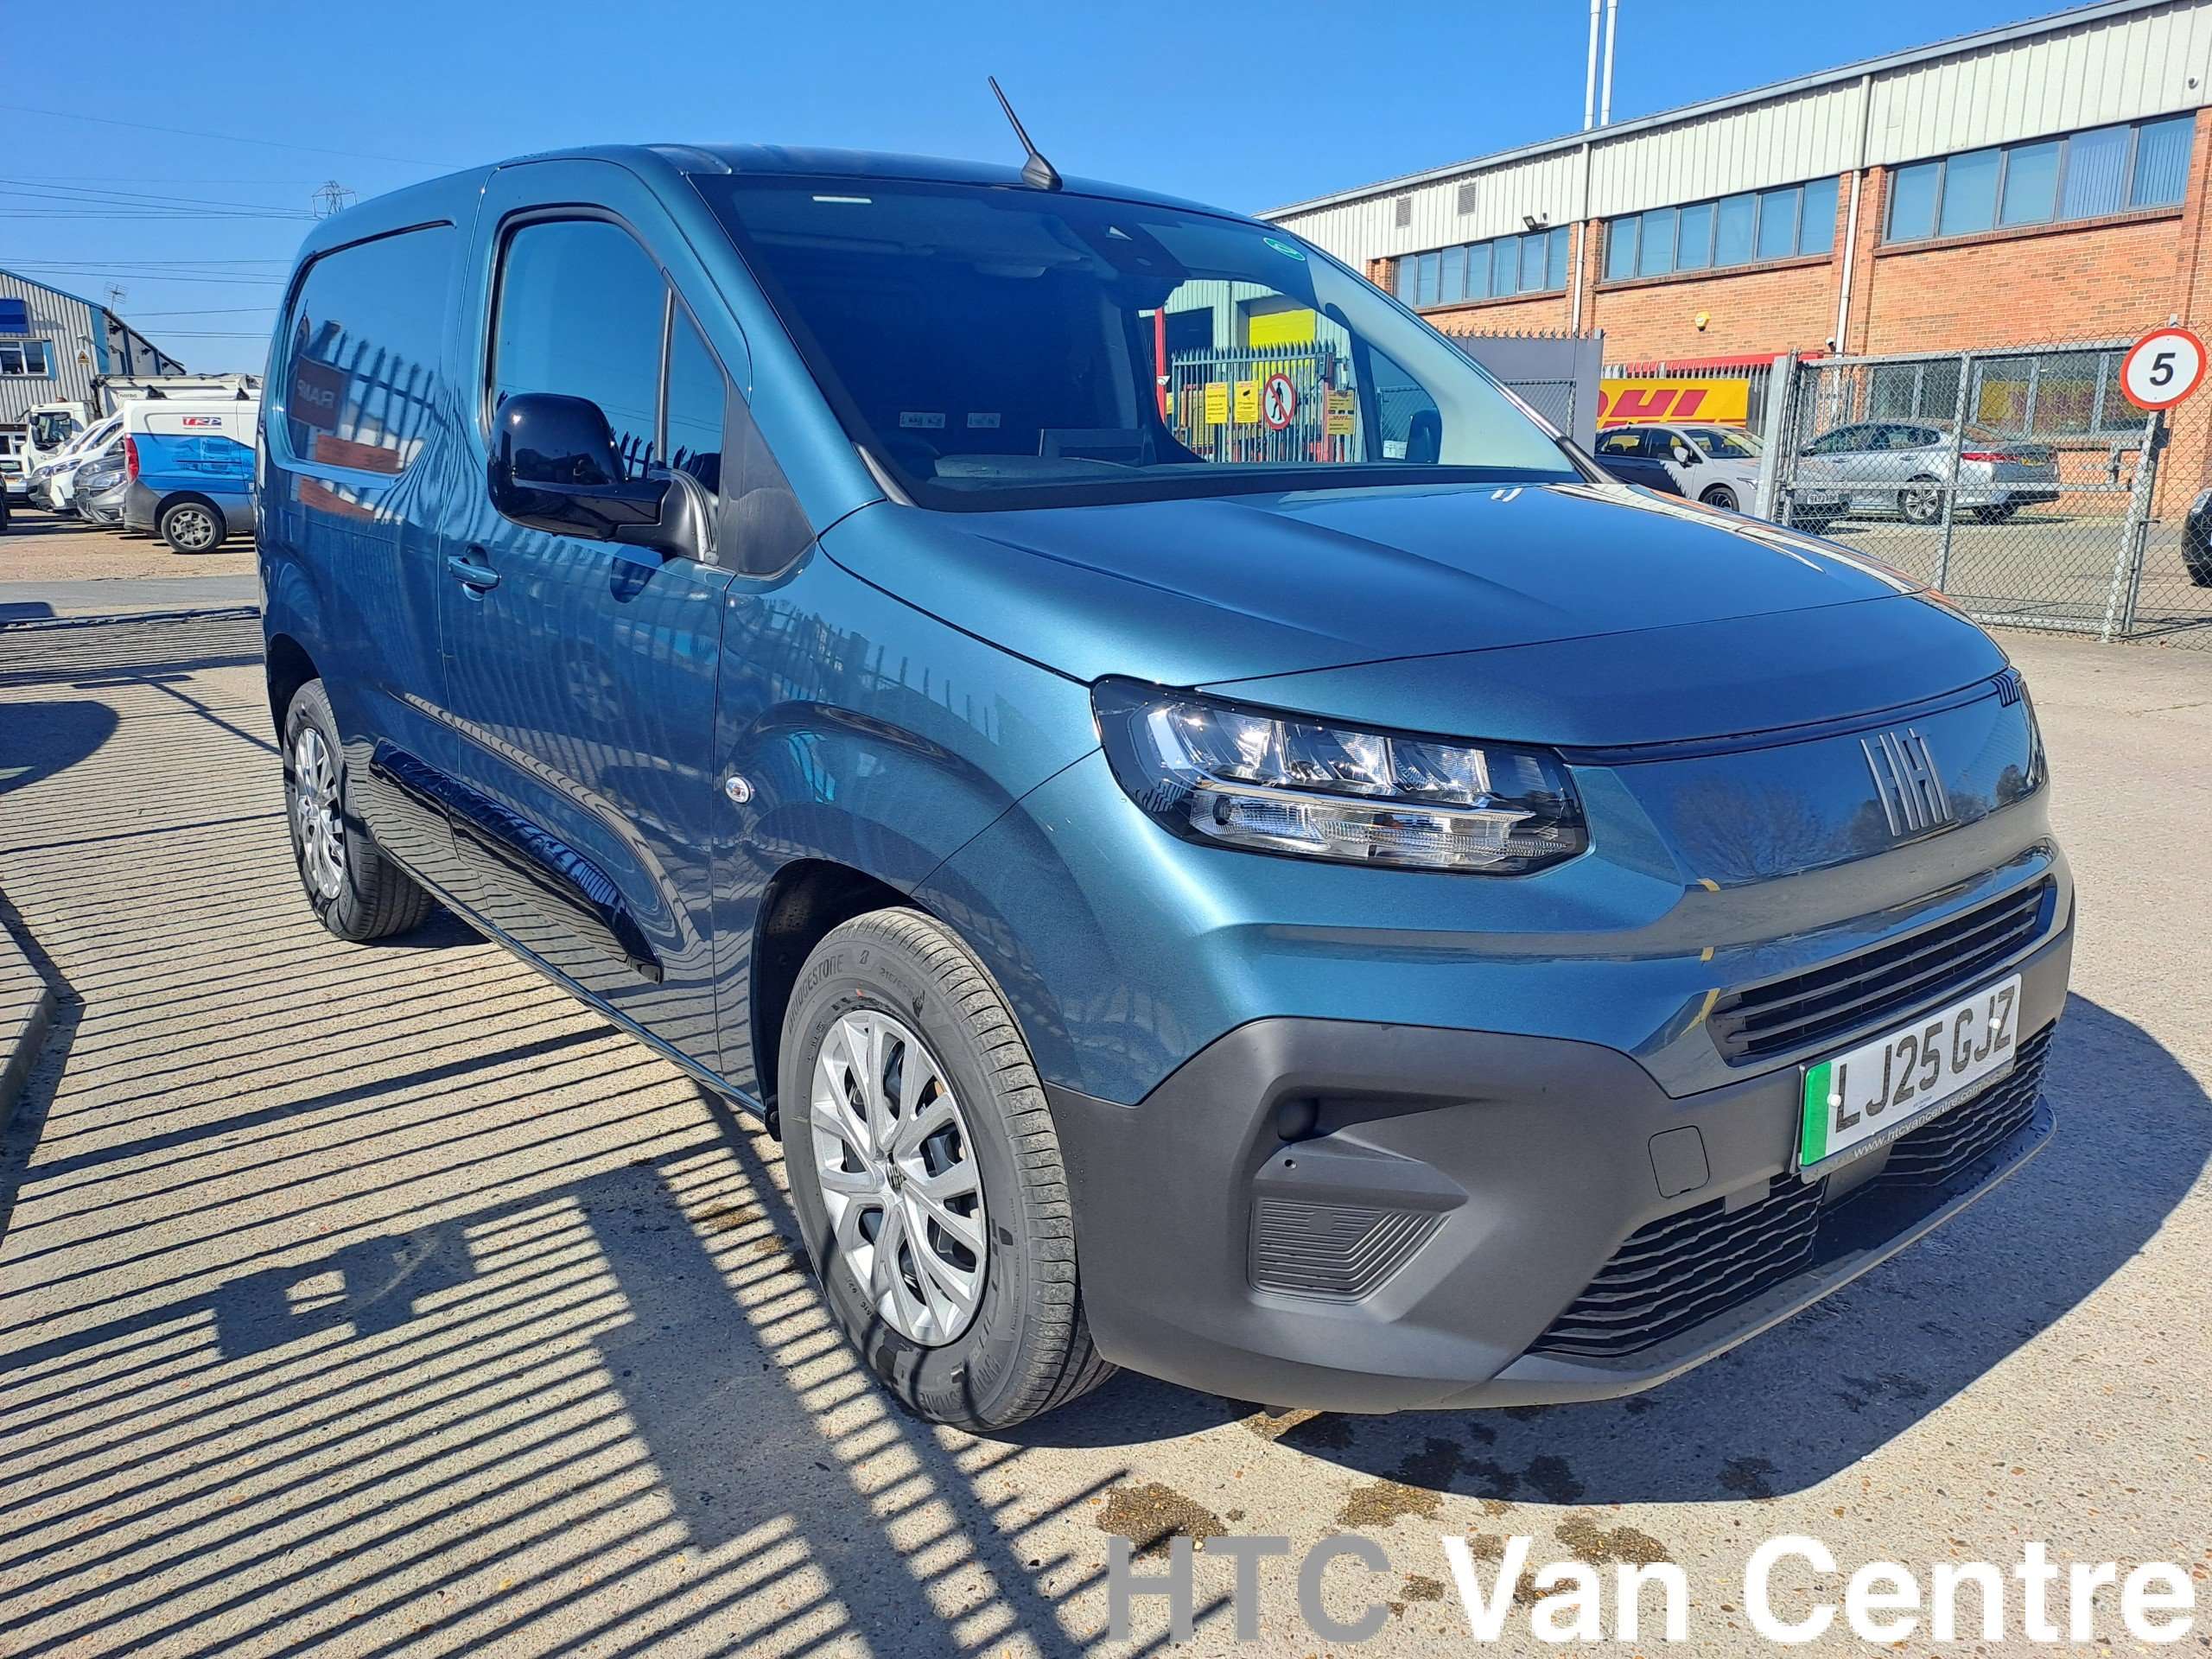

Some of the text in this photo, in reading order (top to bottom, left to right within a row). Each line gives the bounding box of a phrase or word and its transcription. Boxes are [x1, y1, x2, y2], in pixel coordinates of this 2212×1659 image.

[2150, 353, 2176, 386] 5
[788, 954, 844, 1036] BRIDGESTONE
[1836, 986, 2014, 1134] LJ25 GJZ
[1853, 1084, 1984, 1159] www.htcvancentre.com
